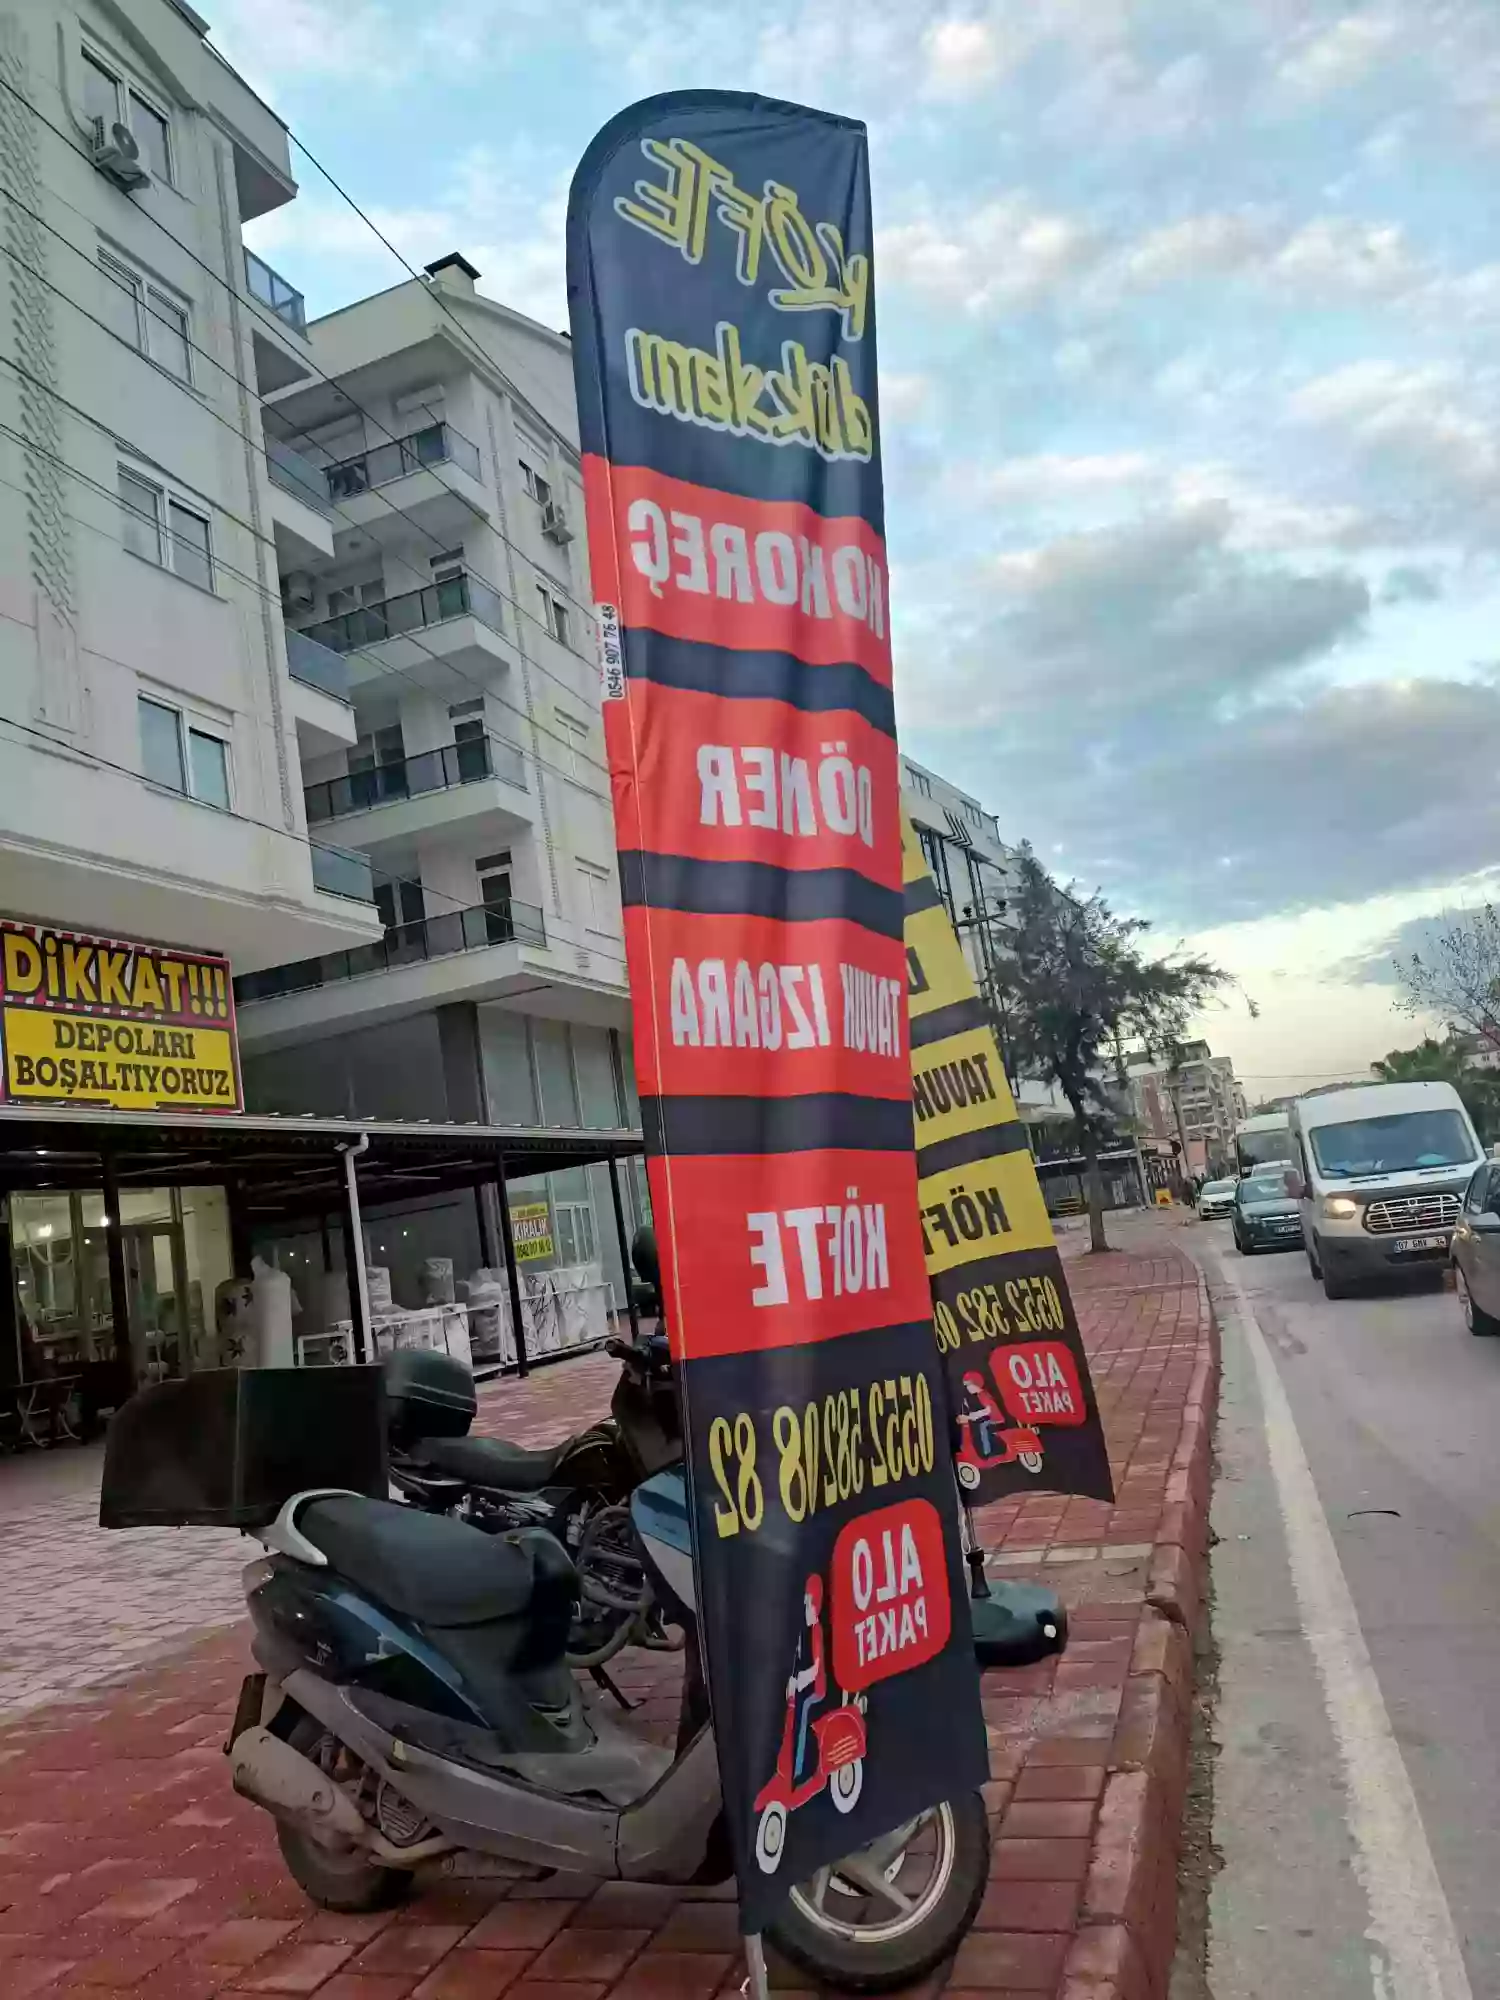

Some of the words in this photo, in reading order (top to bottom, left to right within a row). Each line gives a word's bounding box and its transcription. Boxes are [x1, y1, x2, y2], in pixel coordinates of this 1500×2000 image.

[604, 641, 620, 665] 907
[606, 667, 624, 698] 0546
[53, 1019, 196, 1060] DEPOLARI
[14, 1054, 230, 1096] BOŞALTIYORUZ
